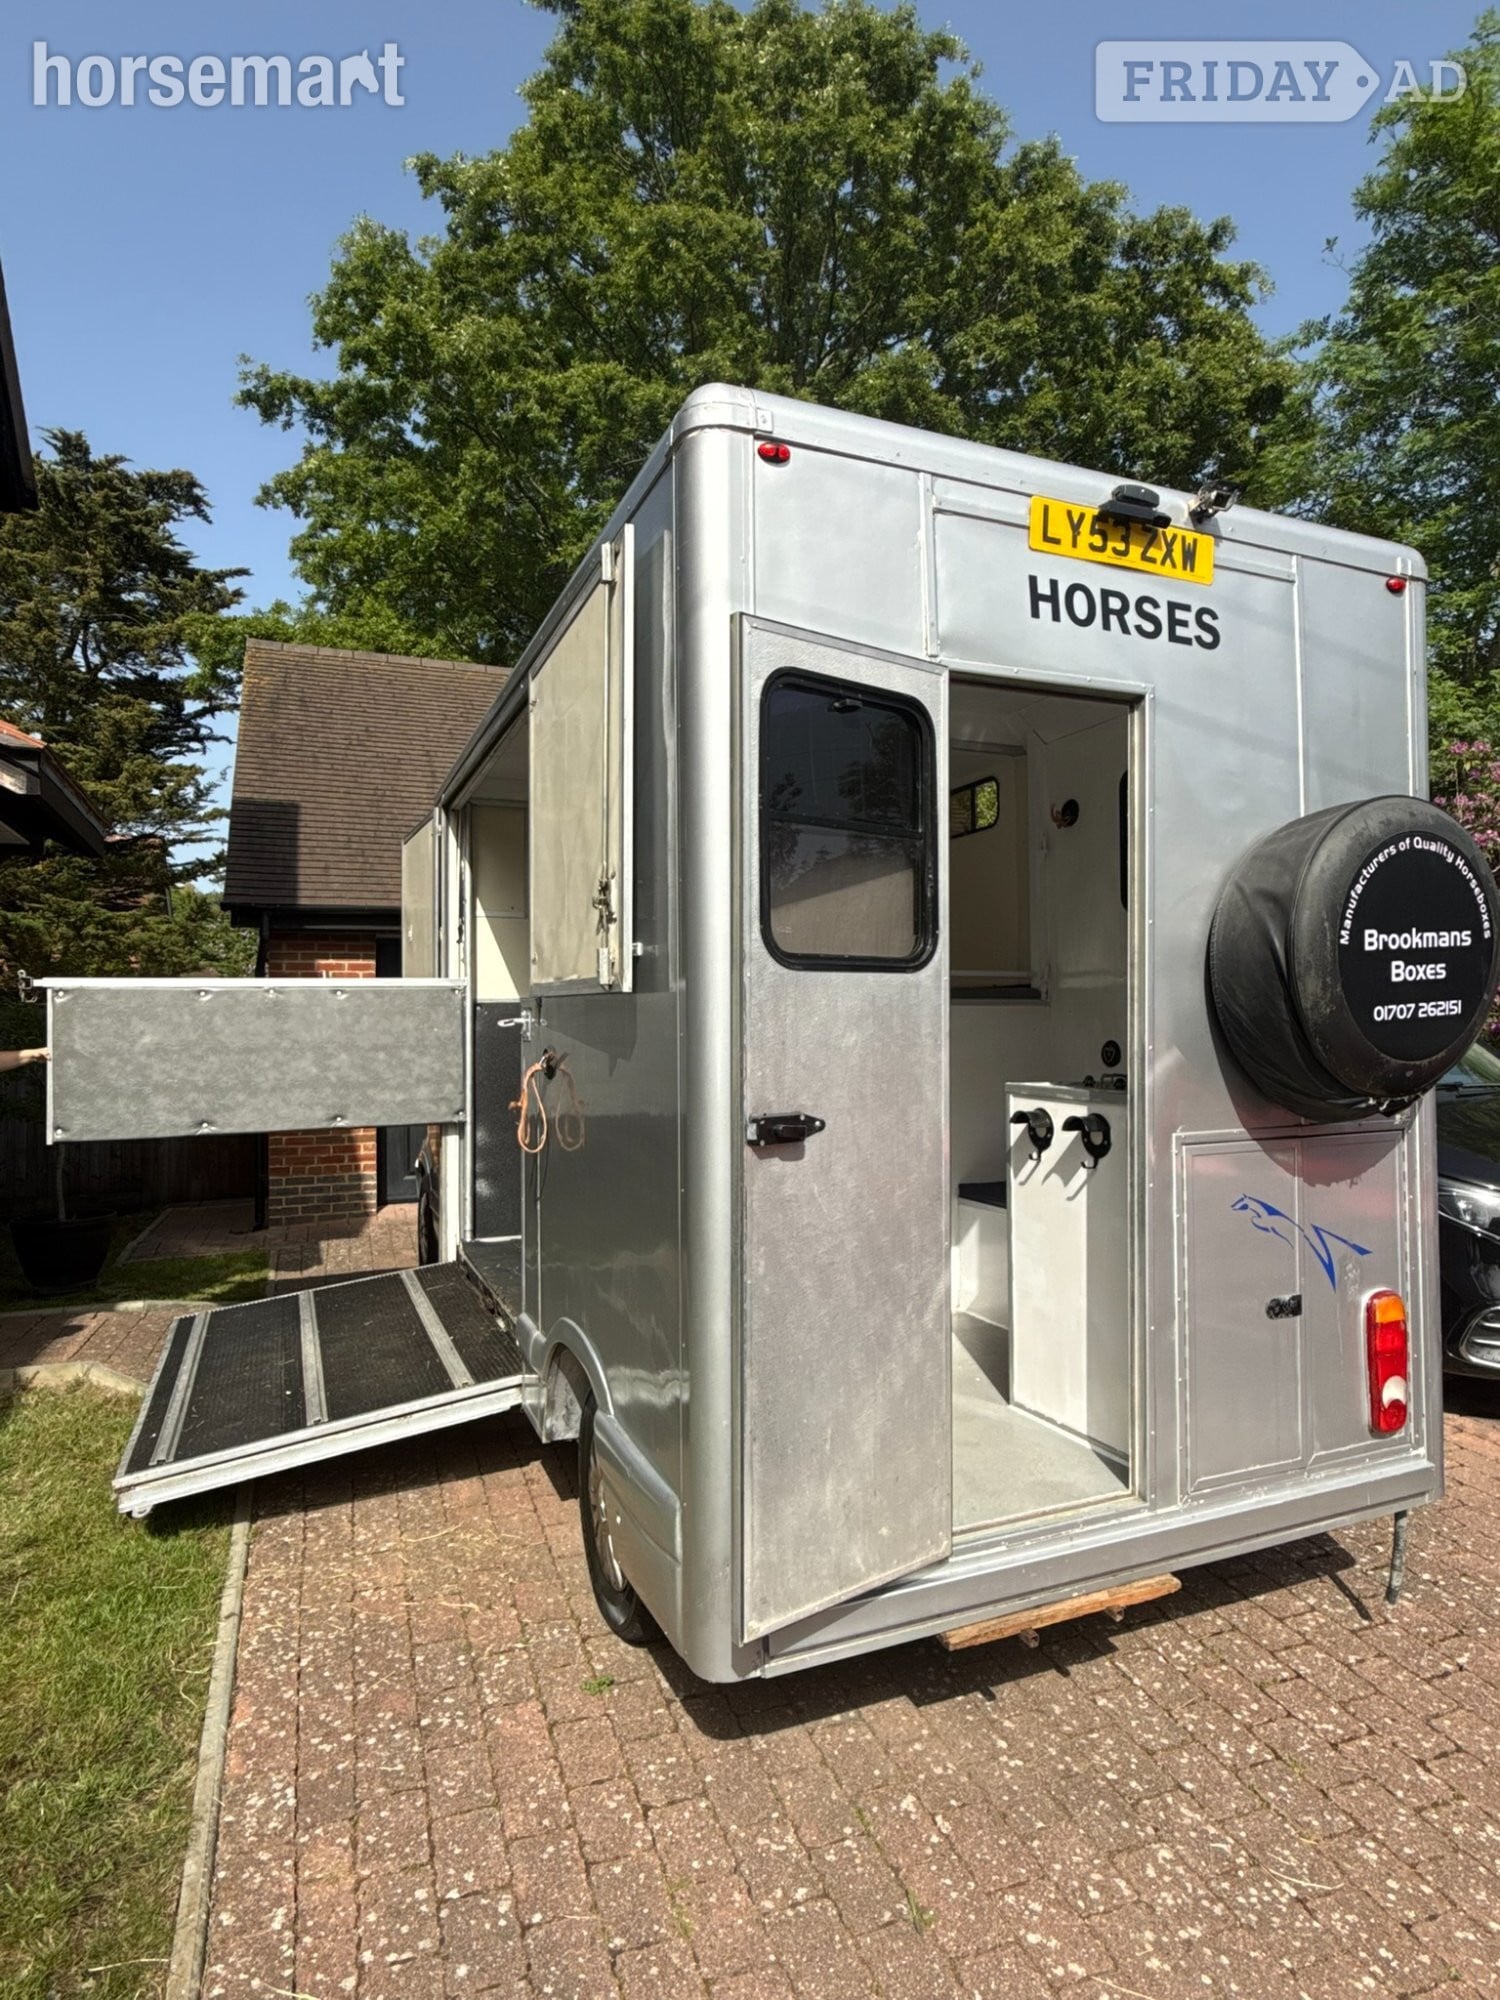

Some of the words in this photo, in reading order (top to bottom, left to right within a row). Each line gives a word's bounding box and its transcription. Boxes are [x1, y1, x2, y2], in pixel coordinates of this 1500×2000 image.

[1042, 503, 1131, 558] LY53
[1140, 523, 1198, 573] ZXW
[1028, 573, 1221, 651] HORSES
[1339, 844, 1397, 945] Manufacturers
[1398, 836, 1411, 851] of
[1412, 836, 1455, 863] Quality
[1454, 855, 1492, 940] Horseboxes
[1363, 927, 1472, 951] Brookmans
[1390, 960, 1447, 982] Boxes
[1373, 1002, 1415, 1021] 01707
[1418, 999, 1462, 1018] 262151
